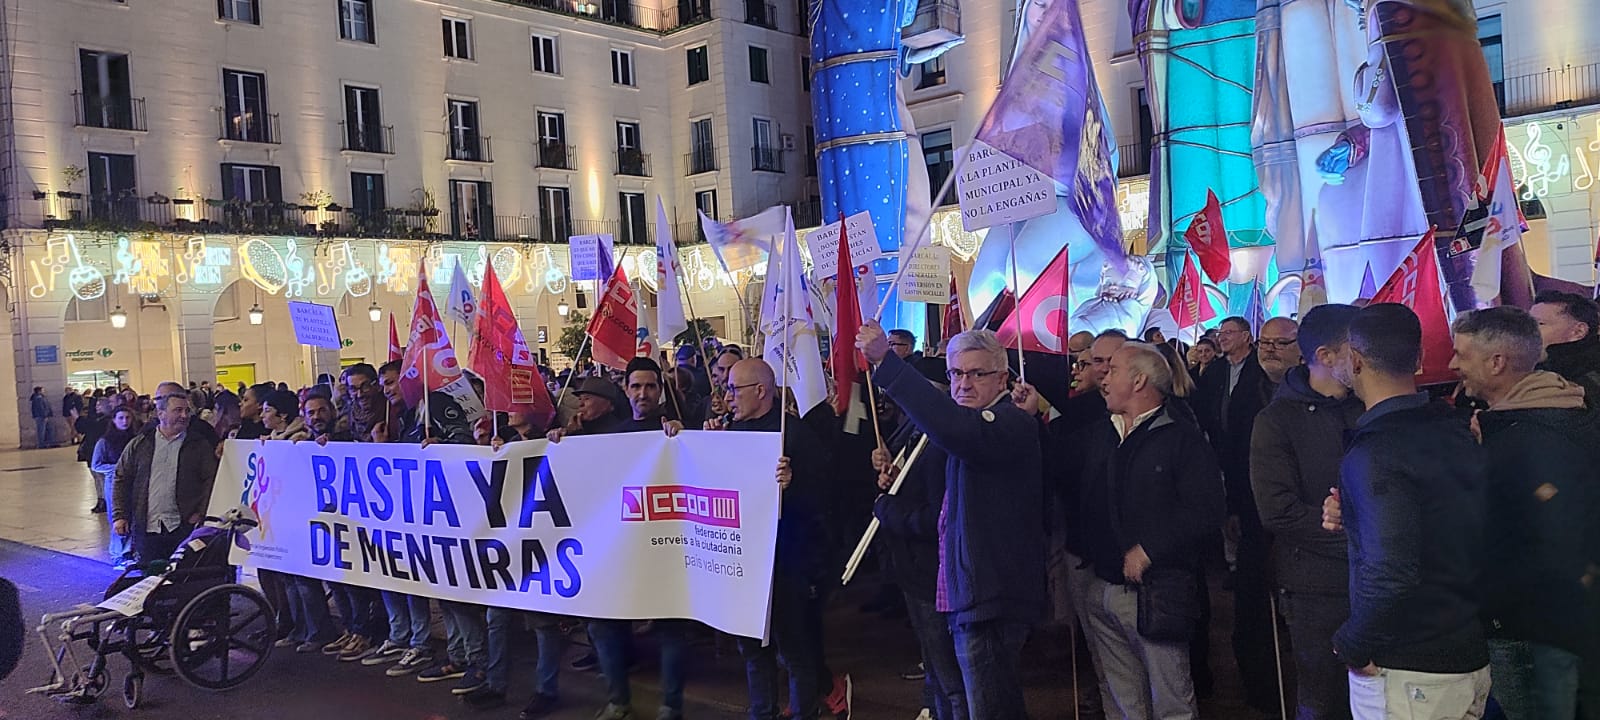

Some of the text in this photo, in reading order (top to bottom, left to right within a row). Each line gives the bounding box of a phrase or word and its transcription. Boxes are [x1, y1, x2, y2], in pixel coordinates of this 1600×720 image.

[965, 173, 1041, 200] MUNICIPAL YA
[967, 171, 980, 182] LA
[964, 189, 1048, 220] NO LA ENGAÑAS
[821, 250, 835, 260] LOS
[311, 454, 572, 529] BASTA YA
[652, 492, 710, 517] CCOO
[694, 524, 742, 542] federació de
[650, 534, 743, 556] serveis a la ciutadania
[310, 520, 584, 599] DE MENTIRAS
[703, 557, 744, 578] valencià
